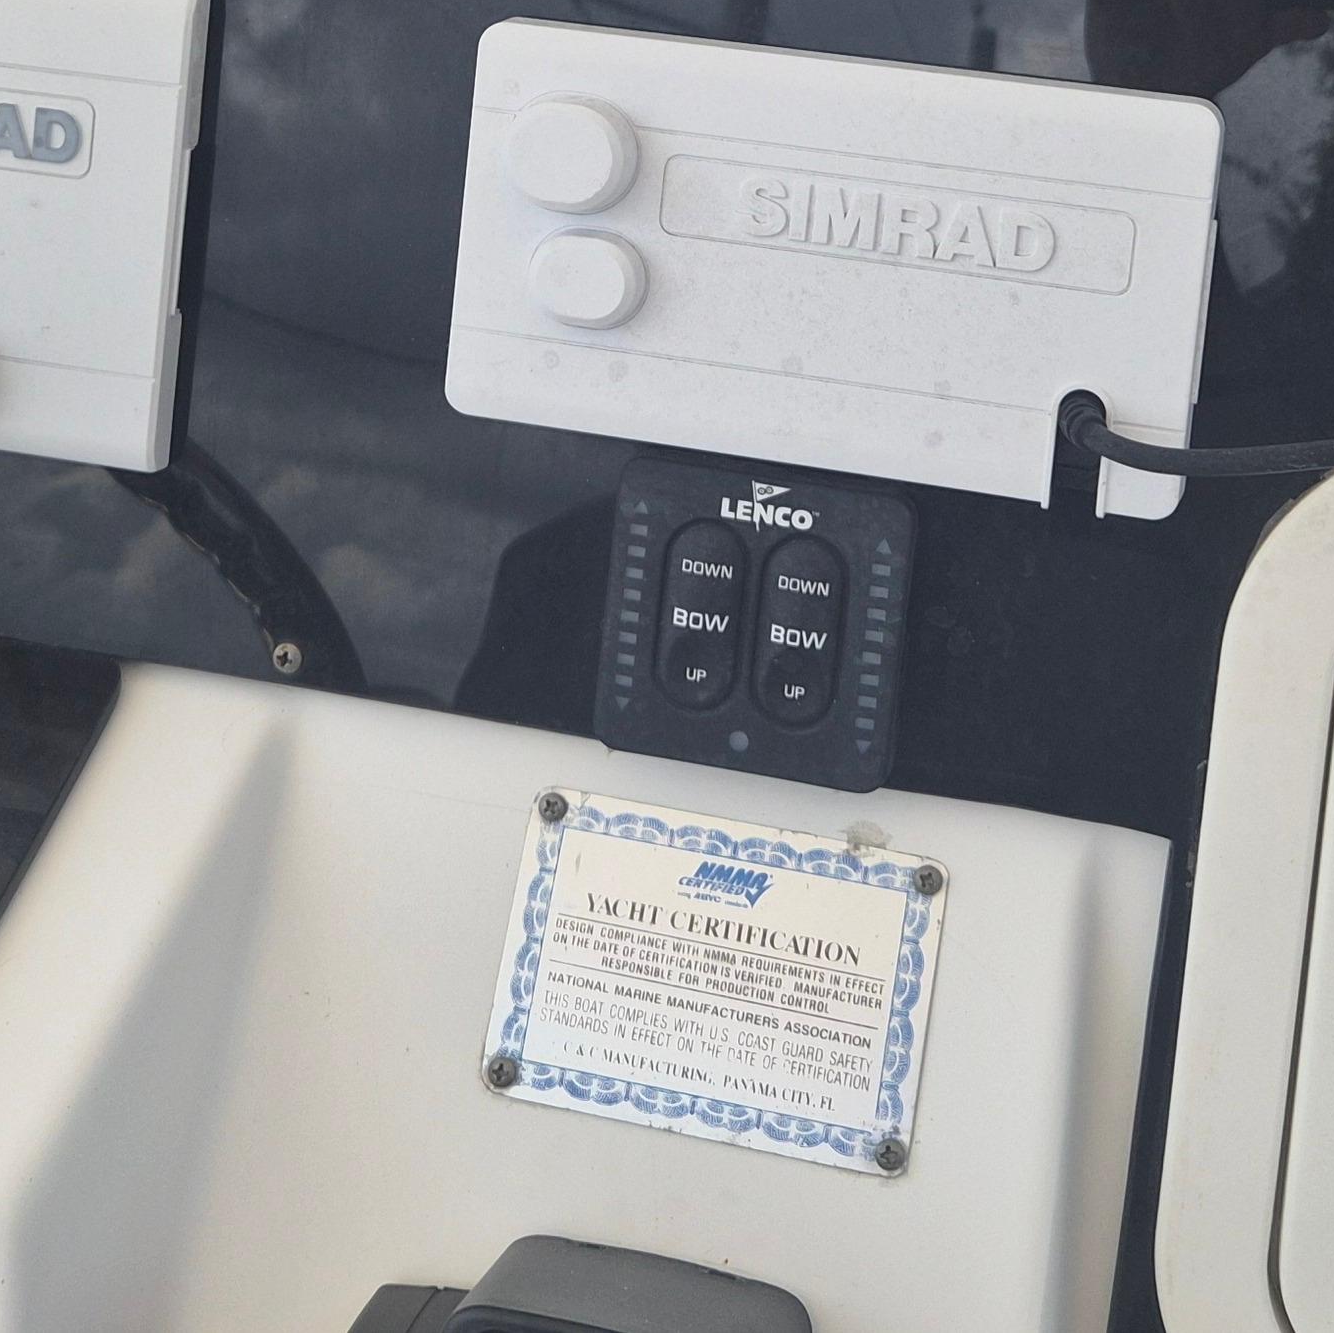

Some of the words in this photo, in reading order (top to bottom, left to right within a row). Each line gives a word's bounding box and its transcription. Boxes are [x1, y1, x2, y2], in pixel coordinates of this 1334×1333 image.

[740, 178, 1057, 272] SIMRAD
[720, 497, 813, 531] LENCO
[682, 558, 733, 580] DOWN
[778, 575, 829, 597] DOWN
[673, 606, 729, 633] BOW
[770, 623, 827, 650] BOW
[686, 667, 707, 683] UP
[783, 684, 805, 700] UP
[678, 876, 745, 896] CERTIFIED
[693, 861, 769, 892] NMMA
[587, 893, 663, 925] YACHT
[670, 911, 860, 966] CERTIFICATION
[552, 931, 568, 945] ON
[571, 935, 589, 949] THE
[592, 939, 619, 955] DATE
[622, 945, 636, 958] OF
[638, 949, 718, 976] CERTIFICATION
[720, 965, 731, 979] IS
[793, 981, 882, 1010] MANUFACTURER
[555, 917, 595, 936] DESIGN
[600, 927, 668, 951] COMPLIANCE
[672, 941, 700, 957] WITH
[703, 948, 737, 966] NMMA
[741, 955, 825, 983] REQUIREMENTS
[829, 974, 841, 987] IN
[844, 977, 885, 996] EFFECT
[601, 956, 672, 981] RESPONSIBLE
[678, 972, 700, 986] FOR
[705, 977, 775, 1003] PRODUCTION
[780, 993, 829, 1014] CONTROL
[547, 971, 609, 994] NATIONAL
[614, 984, 662, 1005] MARINE
[666, 995, 780, 1030] MANUFACTURERS
[783, 1020, 872, 1050] ASSOCIATION
[539, 1007, 610, 1035] STANDARDS
[613, 1023, 627, 1039] IN
[631, 1026, 672, 1048] EFFECT
[677, 1035, 695, 1054] ON
[727, 1046, 757, 1067] DATE
[762, 1054, 778, 1071] OF
[544, 989, 570, 1009] THIS
[574, 996, 604, 1016] BOAT
[609, 1003, 668, 1030] COMPLIES
[674, 1017, 704, 1037] WITH
[781, 1040, 824, 1063] GUARD
[829, 1050, 873, 1073] SAFETY
[723, 1074, 777, 1099] PANAMA
